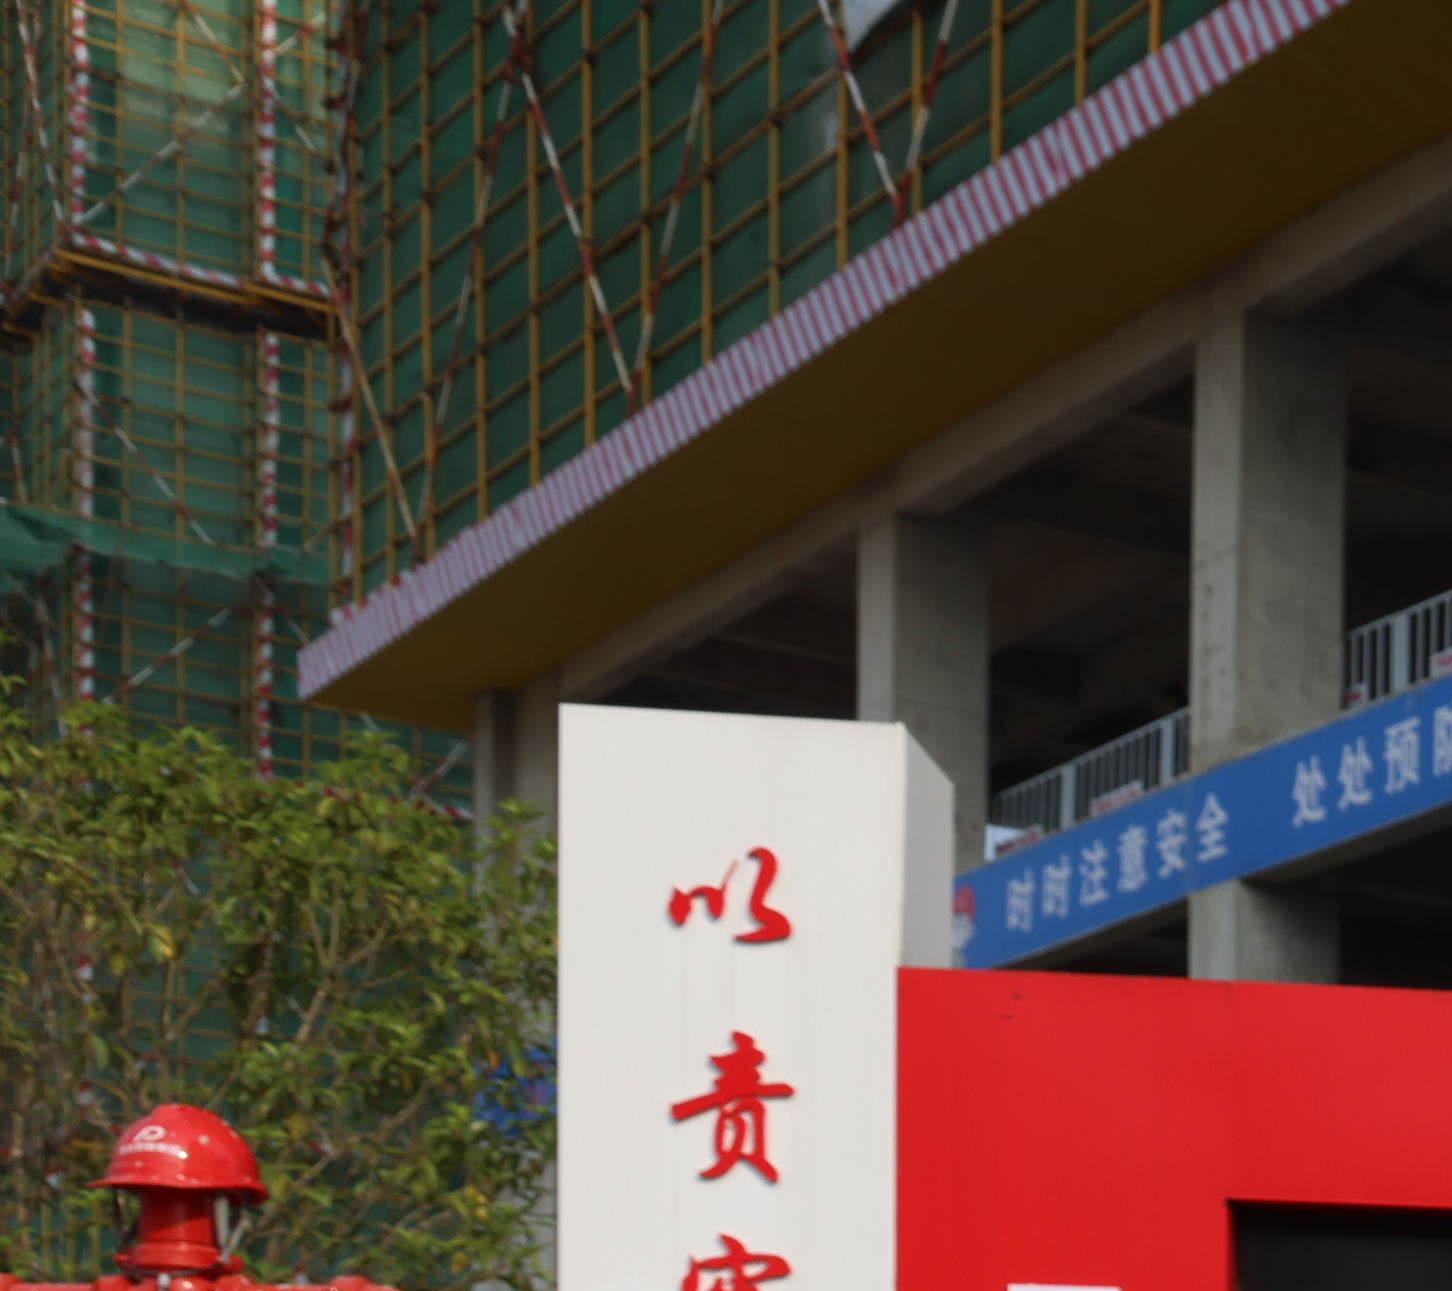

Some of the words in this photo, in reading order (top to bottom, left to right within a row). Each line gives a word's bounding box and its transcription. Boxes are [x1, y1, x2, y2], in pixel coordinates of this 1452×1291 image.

[1006, 792, 1230, 931] 时时注意安全
